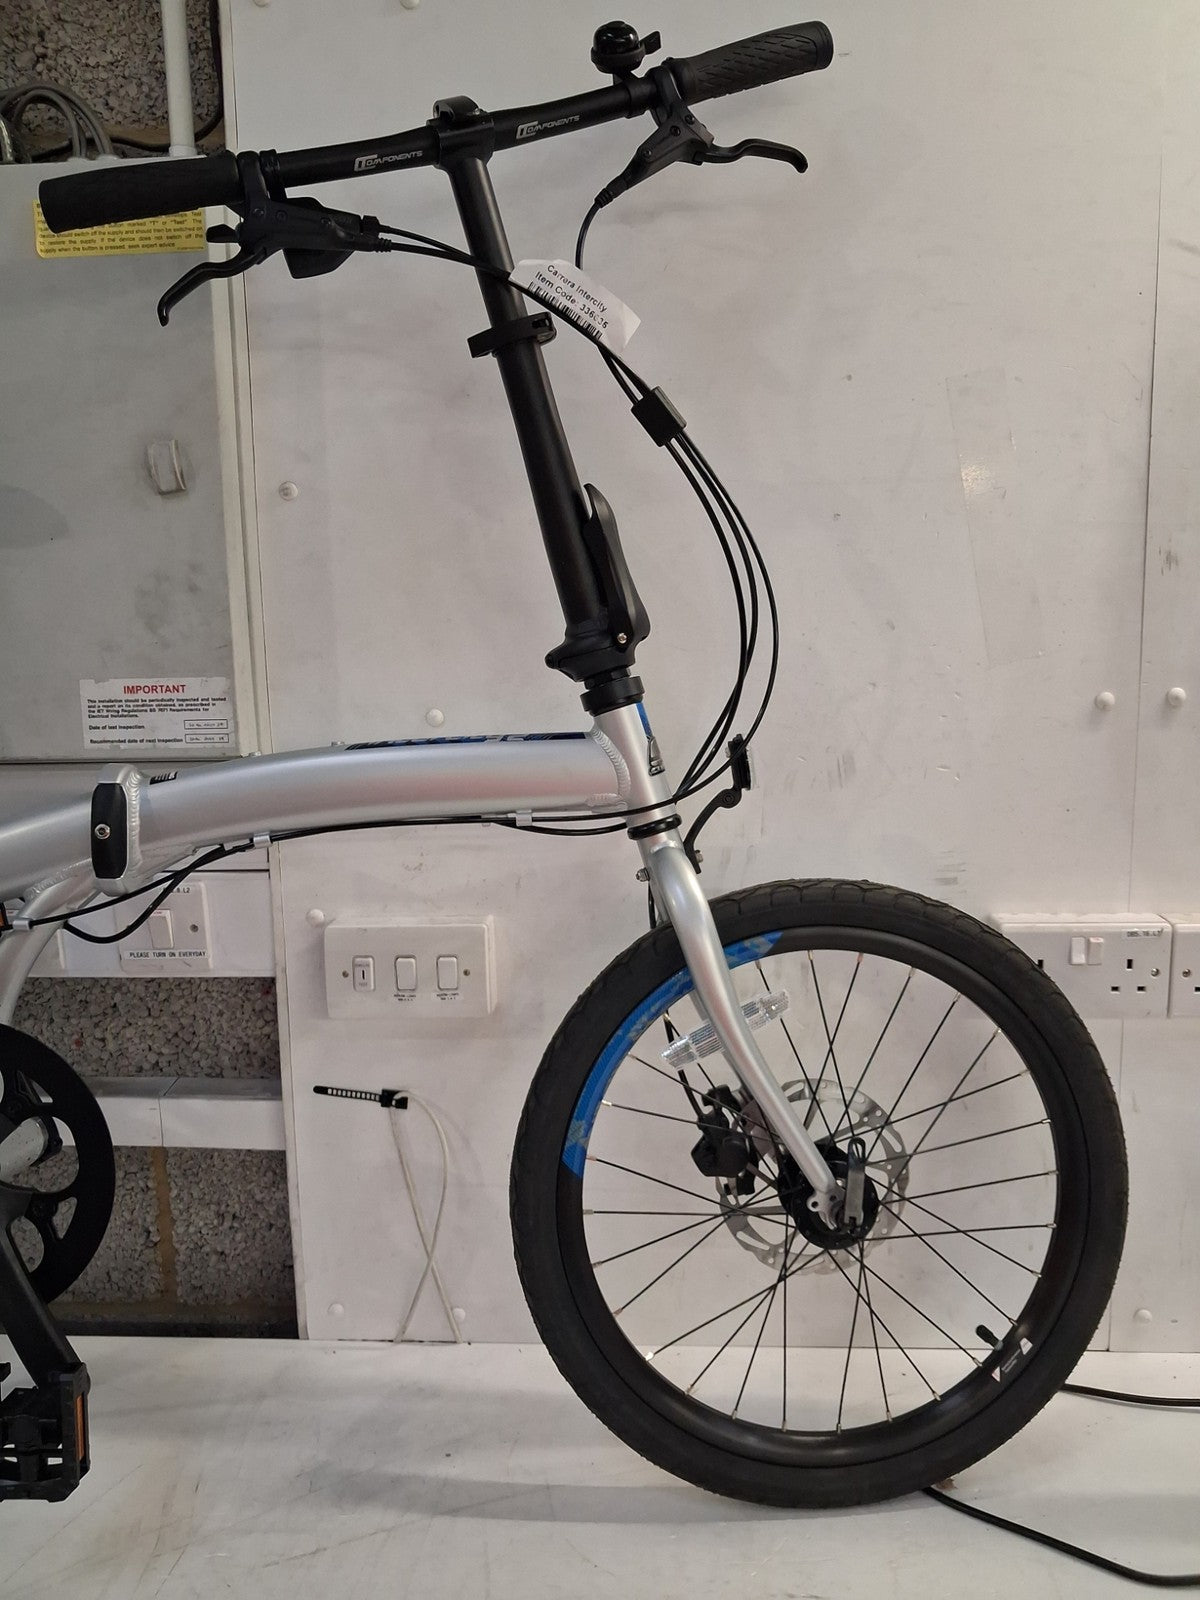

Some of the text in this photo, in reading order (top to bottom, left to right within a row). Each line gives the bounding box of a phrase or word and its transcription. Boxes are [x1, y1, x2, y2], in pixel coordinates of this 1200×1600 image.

[535, 271, 554, 289] Item
[555, 286, 579, 307] Code:
[547, 264, 608, 314] Carrera Intercity
[123, 684, 186, 695] IMPORTANT
